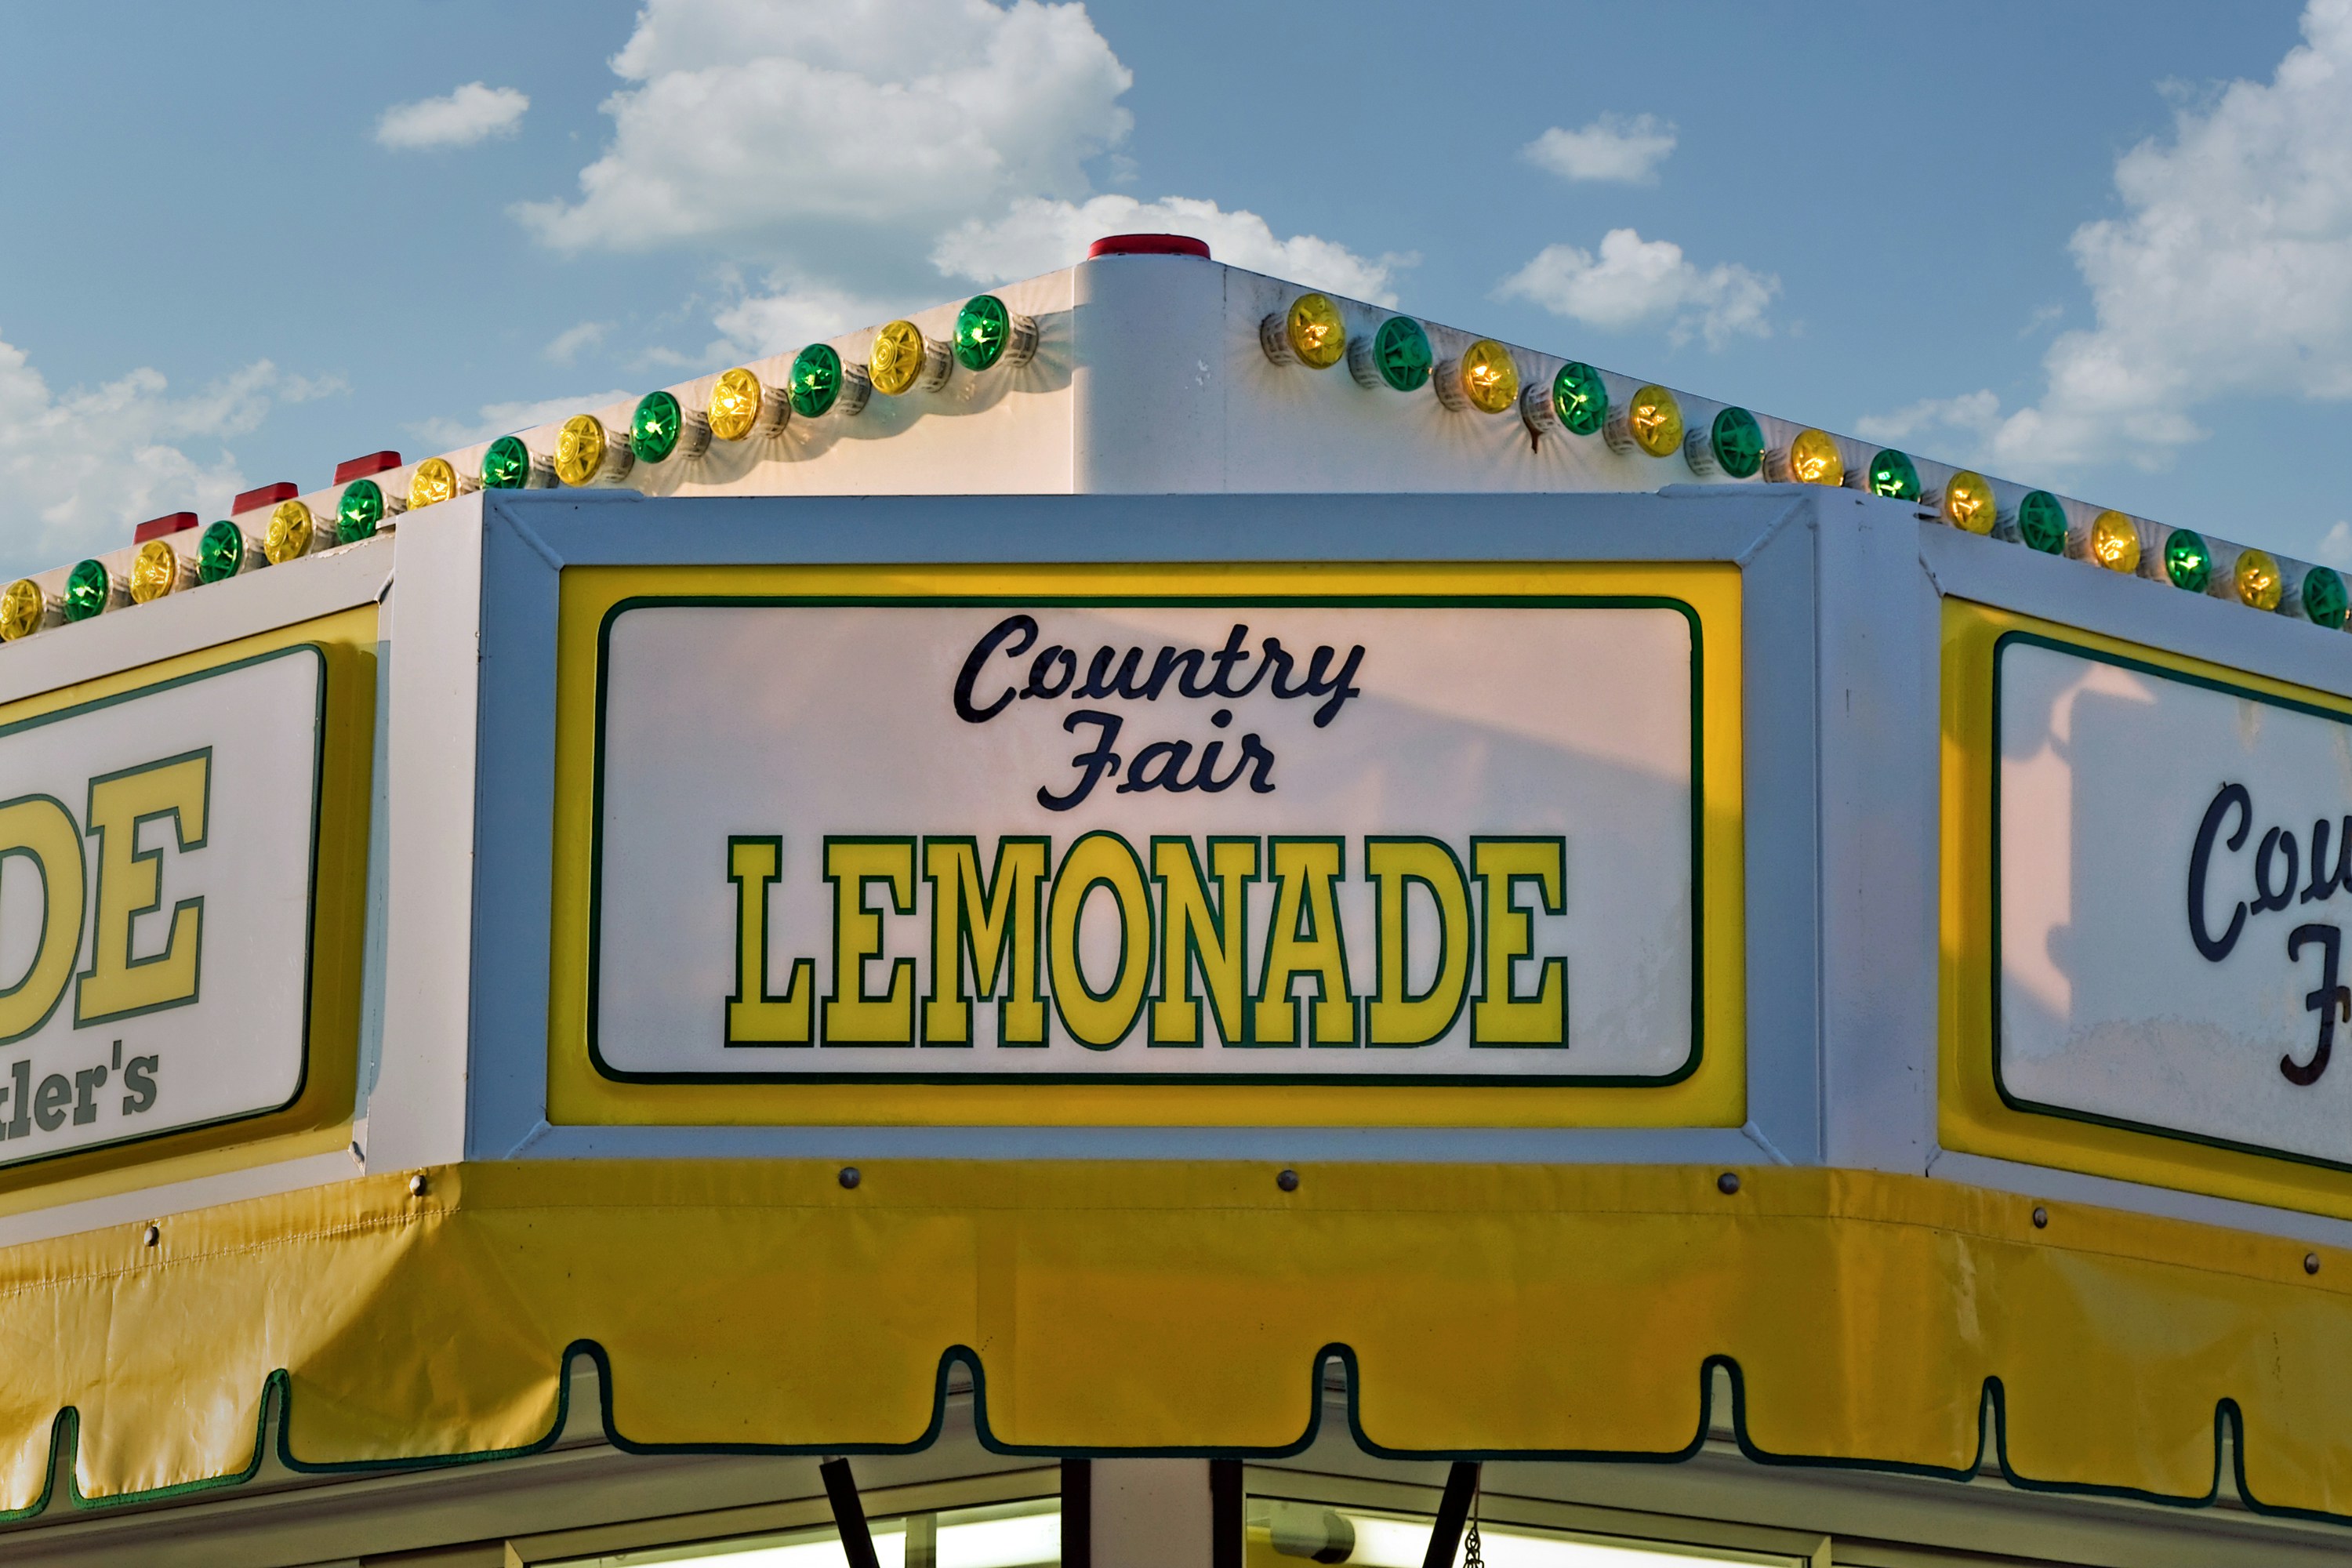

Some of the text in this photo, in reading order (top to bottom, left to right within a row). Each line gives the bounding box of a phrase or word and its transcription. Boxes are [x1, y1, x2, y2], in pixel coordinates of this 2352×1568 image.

[953, 615, 1366, 728] Country
[1036, 709, 1276, 811] Fair
[724, 829, 1569, 1051] LEMONADE
